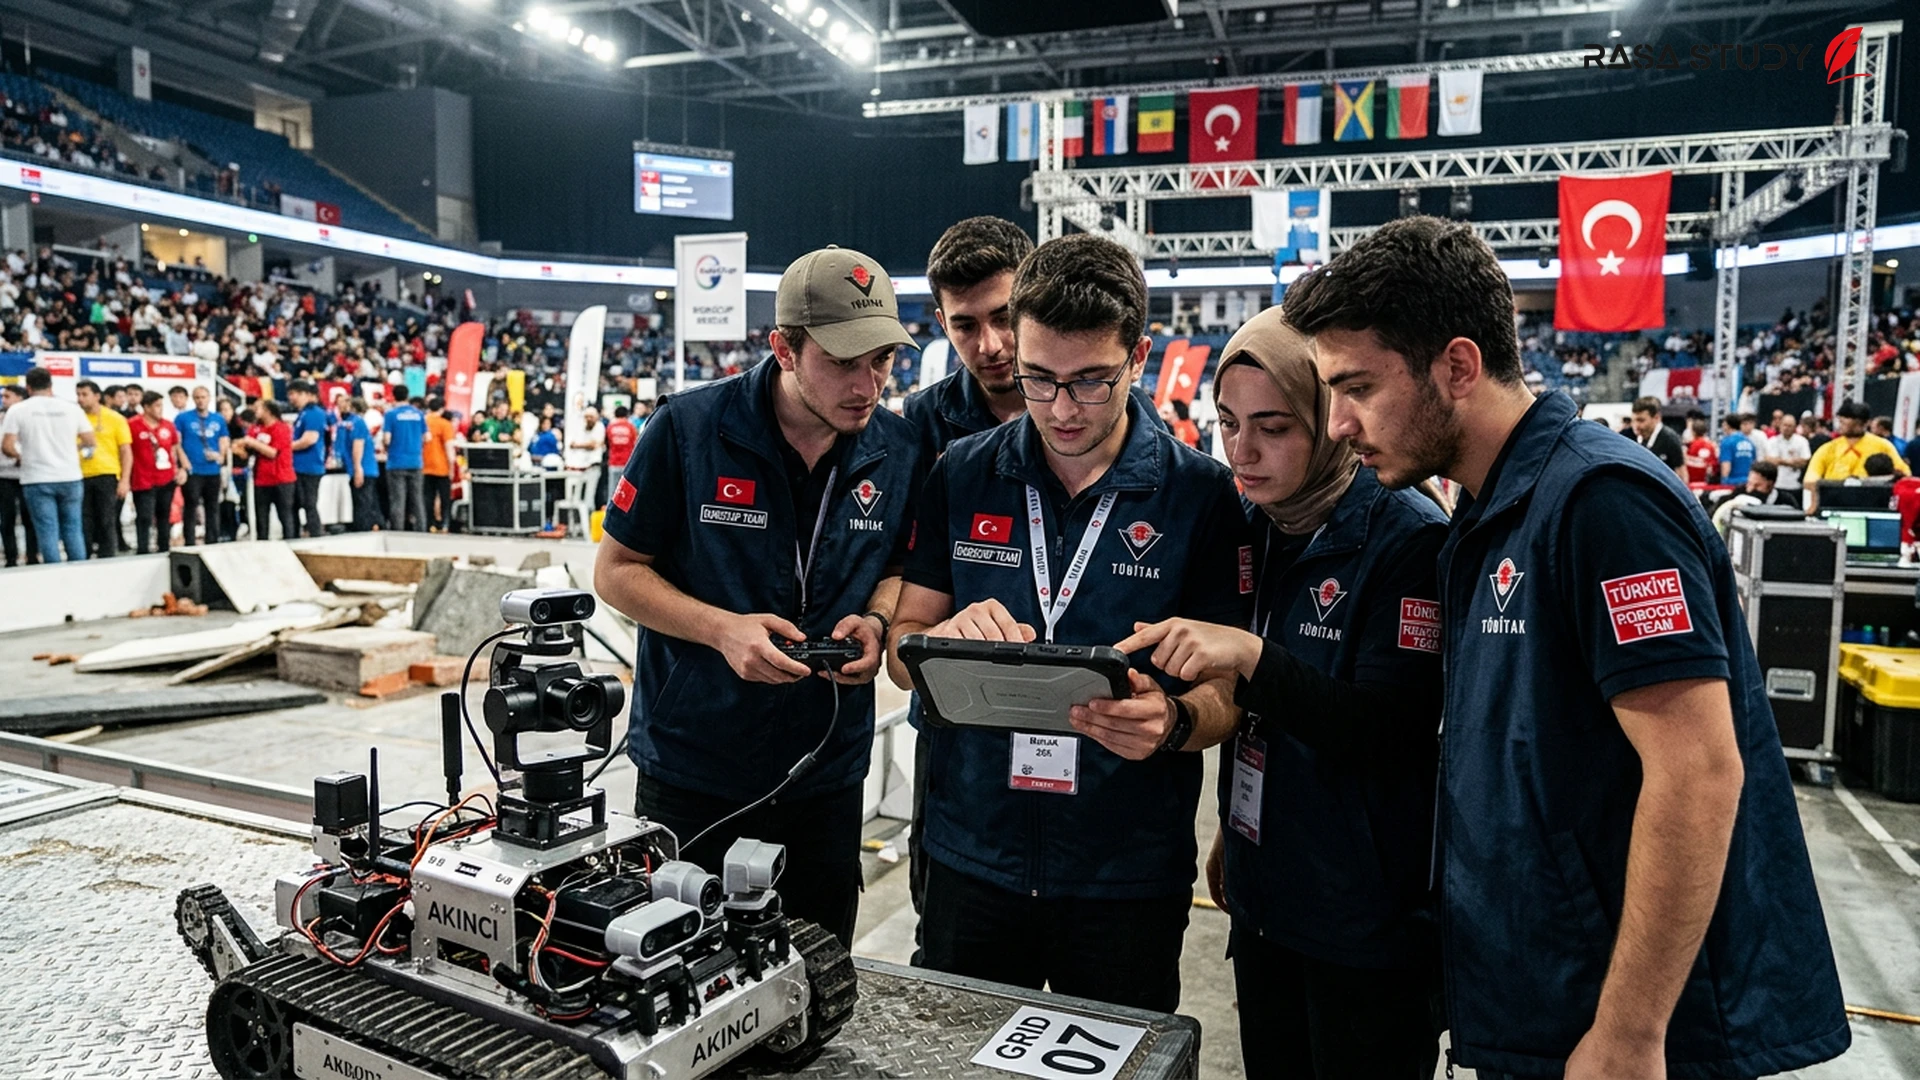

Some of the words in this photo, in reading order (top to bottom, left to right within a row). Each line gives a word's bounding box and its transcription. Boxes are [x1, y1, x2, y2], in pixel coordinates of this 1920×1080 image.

[1608, 575, 1679, 603] TÜRKİYE
[427, 900, 499, 942] AKINCI
[690, 1007, 760, 1069] AKINCI
[995, 1016, 1051, 1060] GRID
[1041, 1023, 1121, 1075] 07
